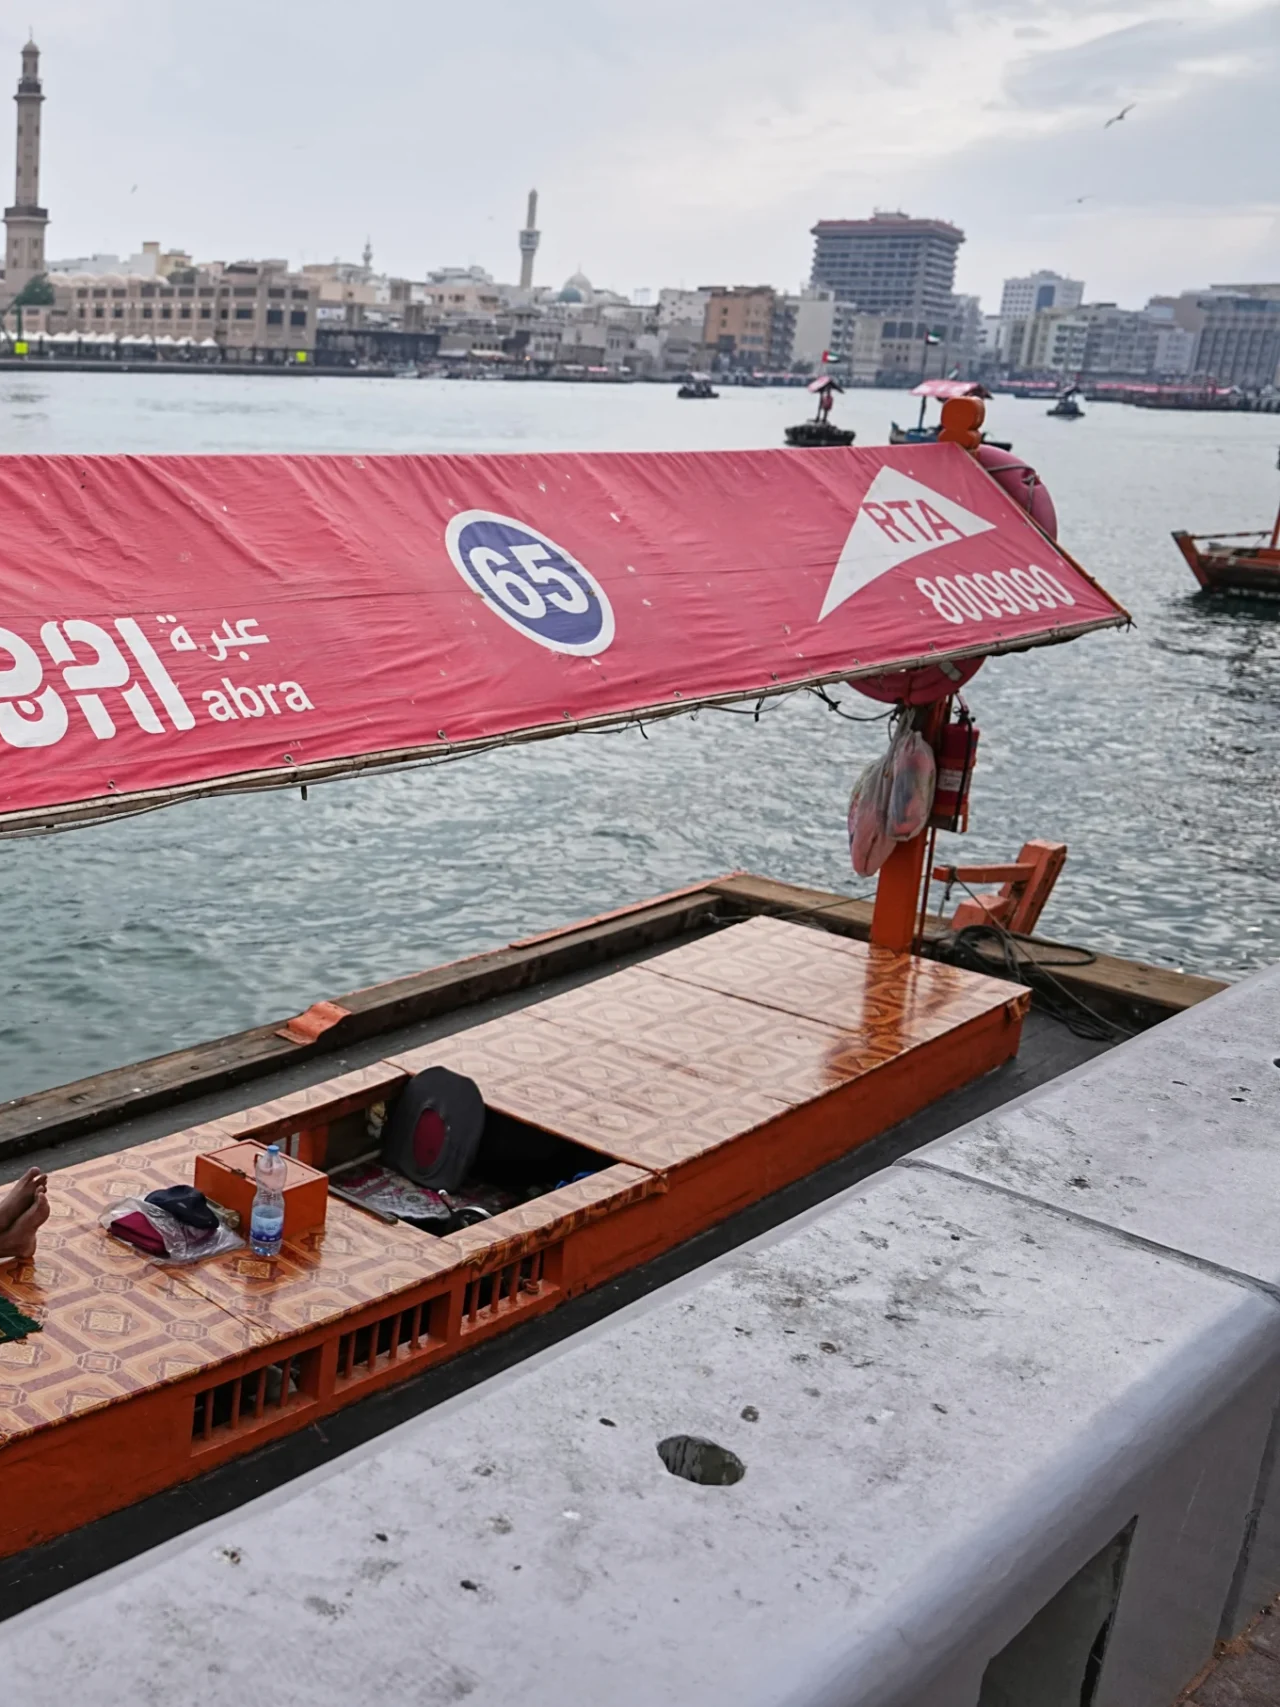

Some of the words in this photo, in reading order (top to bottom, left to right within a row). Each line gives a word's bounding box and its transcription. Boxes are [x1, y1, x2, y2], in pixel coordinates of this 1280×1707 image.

[861, 499, 969, 543] RTA
[469, 543, 589, 619] 65
[915, 564, 1076, 625] 8009090
[155, 614, 270, 662] عبرة
[202, 677, 316, 722] abra
